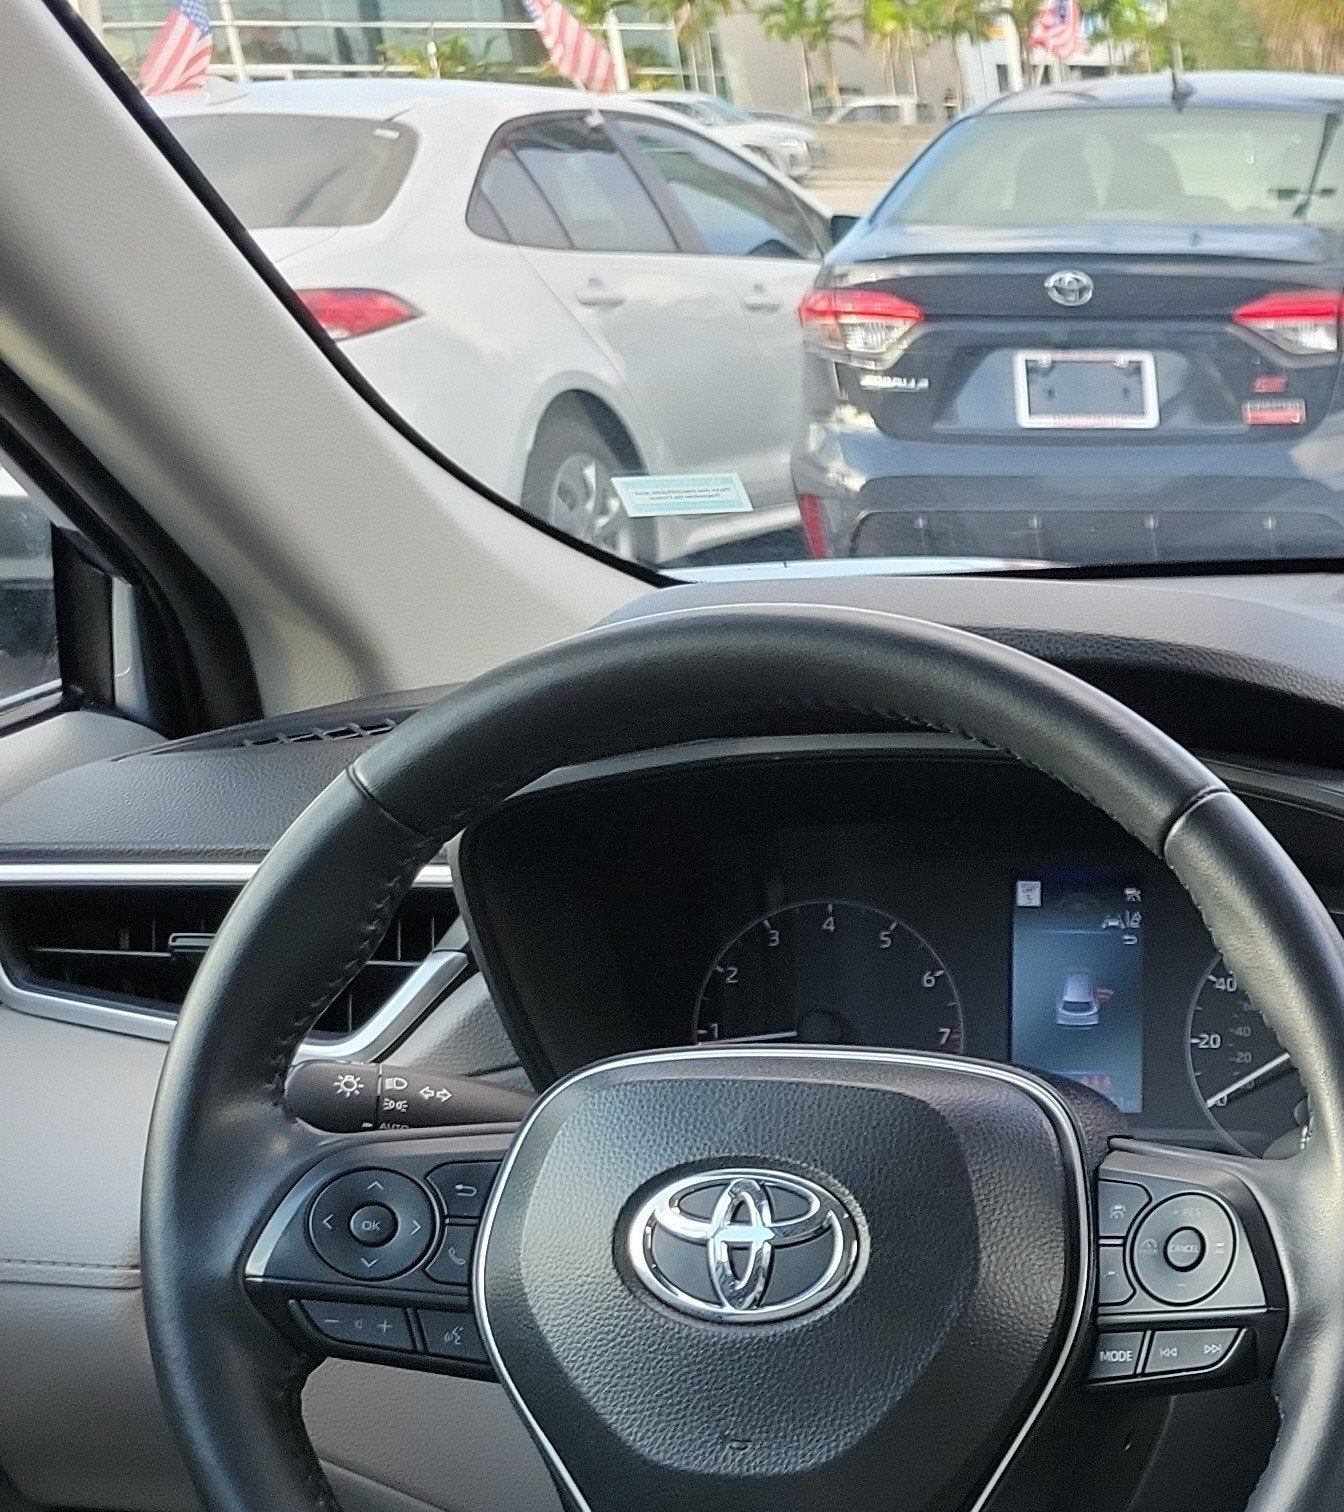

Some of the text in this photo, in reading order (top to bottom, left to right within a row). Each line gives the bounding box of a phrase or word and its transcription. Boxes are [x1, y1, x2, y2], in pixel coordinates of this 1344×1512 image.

[822, 916, 835, 931] 4
[768, 930, 780, 947] 3
[879, 931, 892, 948] 5
[725, 967, 738, 984] 2
[922, 971, 936, 988] 6
[1214, 978, 1237, 992] 40
[711, 1023, 719, 1039] 1
[938, 1027, 951, 1046] 7
[1200, 1034, 1221, 1049] 20
[362, 1220, 380, 1231] OK
[1170, 1244, 1199, 1253] CANCEL
[1099, 1350, 1134, 1362] MODE
